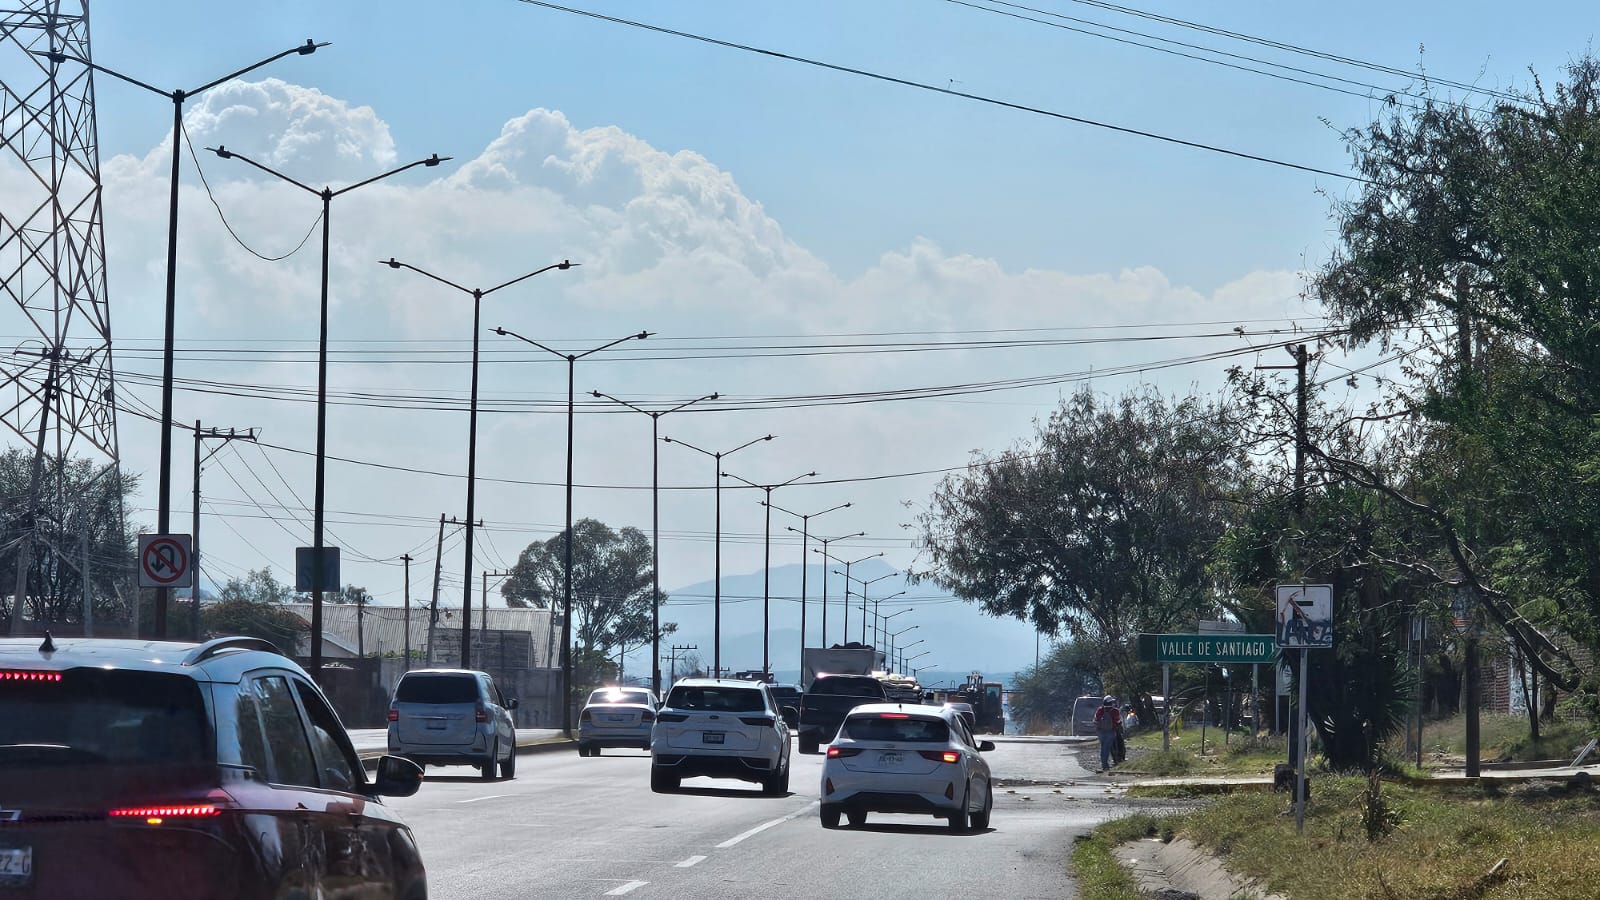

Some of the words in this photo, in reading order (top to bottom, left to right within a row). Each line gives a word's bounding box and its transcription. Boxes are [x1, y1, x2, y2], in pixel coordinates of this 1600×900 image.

[1161, 641, 1193, 656] VALLE
[1198, 641, 1211, 656] DE
[1216, 641, 1265, 656] SANTIAGO
